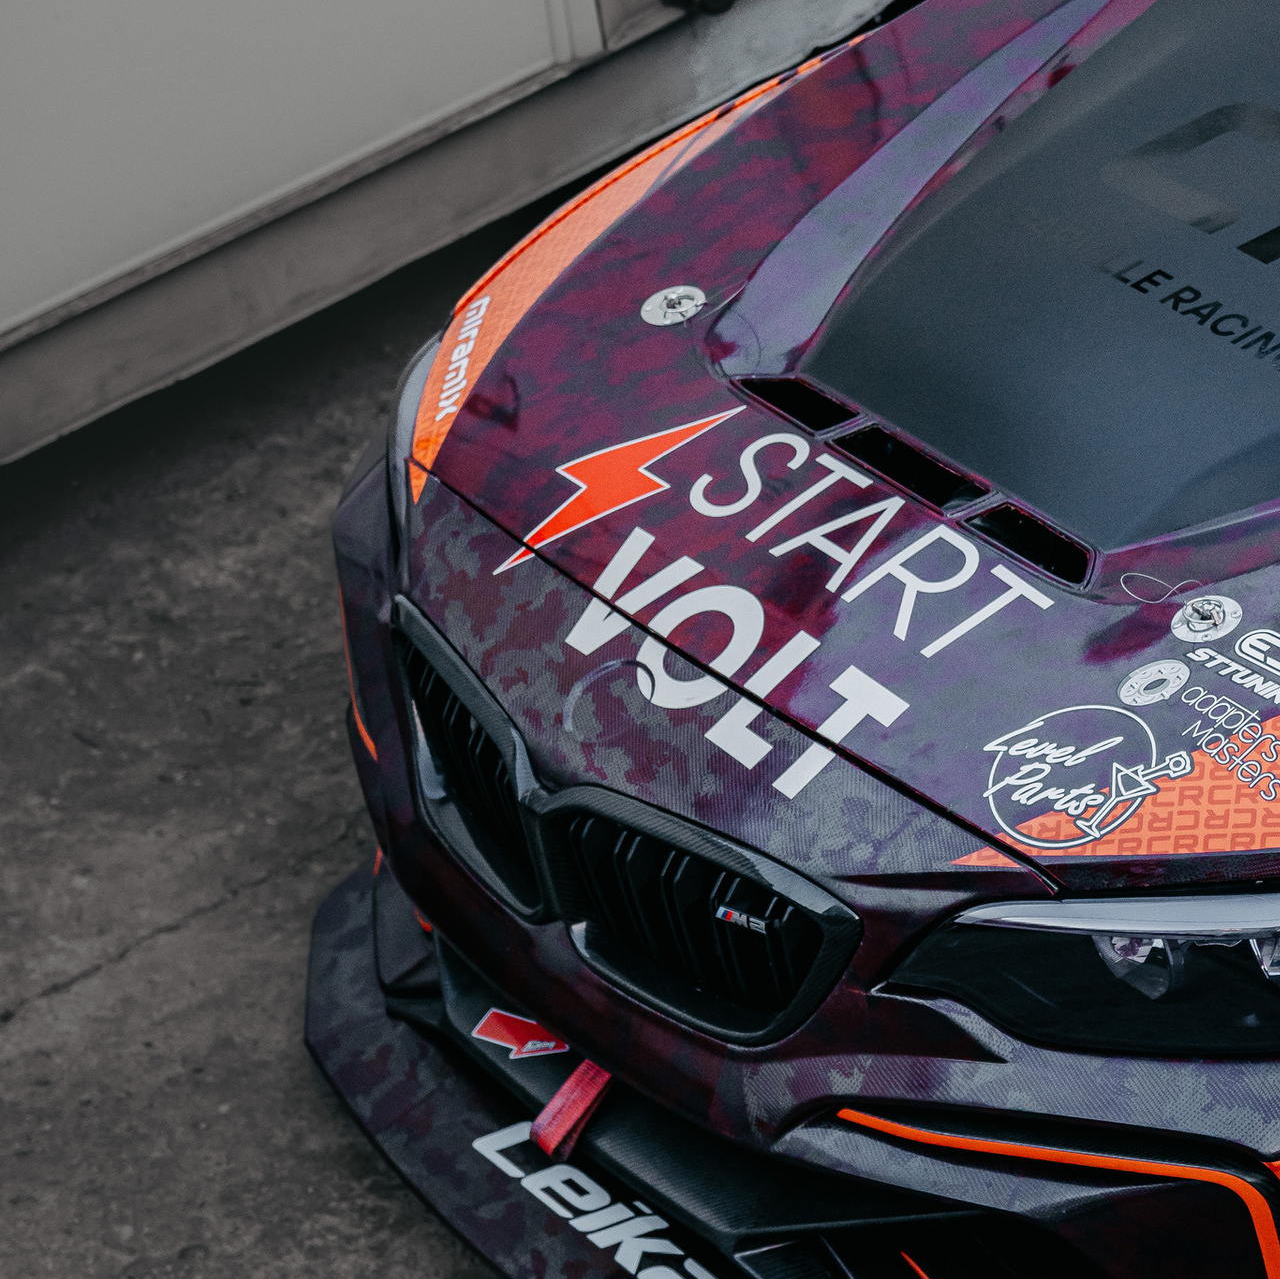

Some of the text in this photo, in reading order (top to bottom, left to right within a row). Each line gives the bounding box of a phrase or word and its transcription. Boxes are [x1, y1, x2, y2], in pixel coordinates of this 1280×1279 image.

[689, 432, 1054, 658] START
[565, 527, 909, 801] VOLT
[983, 720, 1124, 767] Level
[983, 762, 1106, 815] Parts
[731, 910, 767, 934] M2
